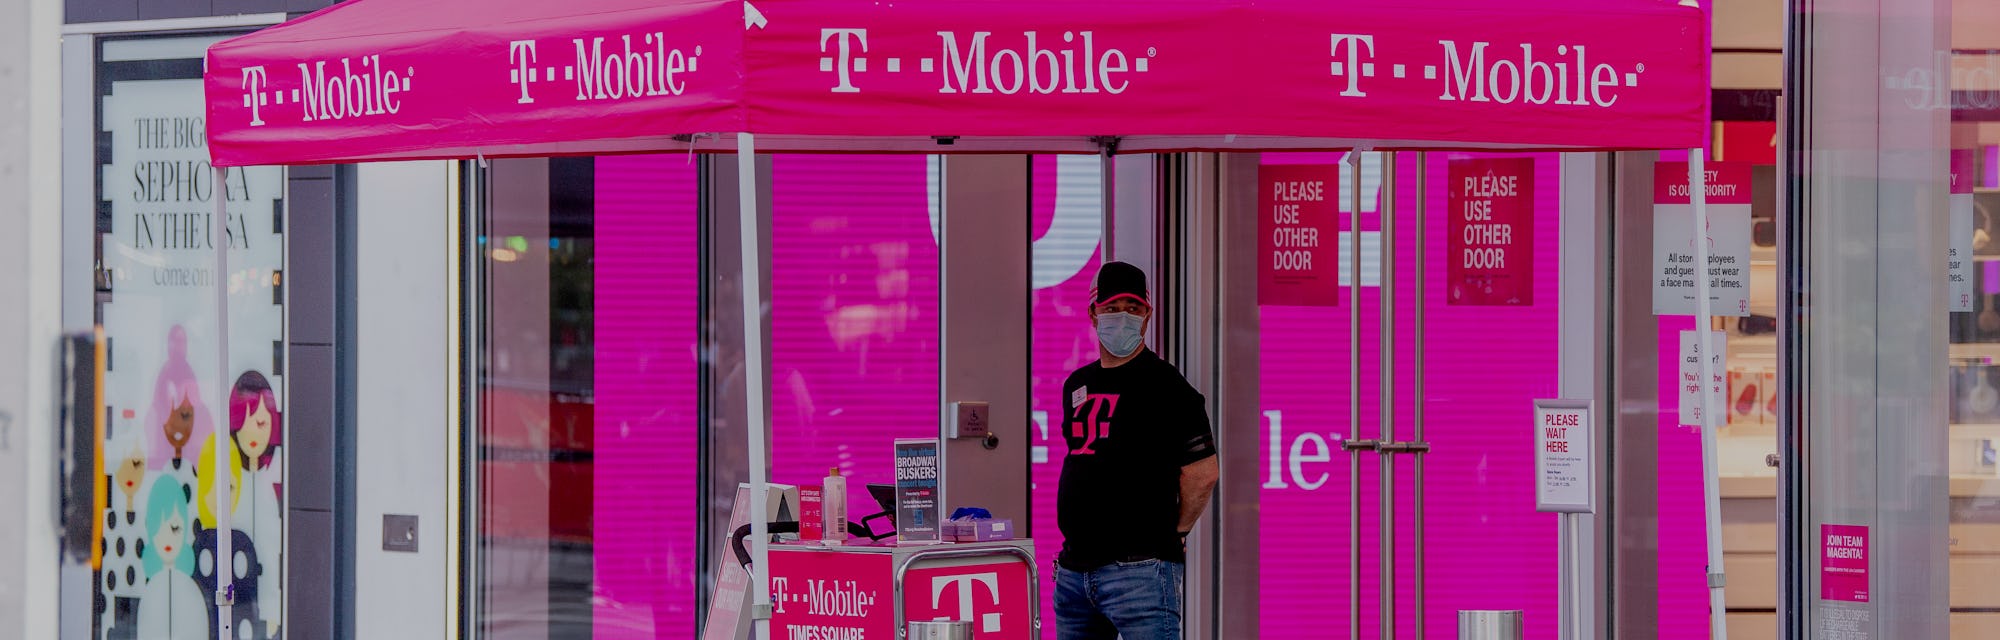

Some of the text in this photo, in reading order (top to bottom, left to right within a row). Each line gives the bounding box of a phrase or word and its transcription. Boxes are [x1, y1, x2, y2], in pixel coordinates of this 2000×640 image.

[135, 116, 208, 149] THE BIG
[1273, 180, 1324, 202] PLEASE
[1464, 175, 1518, 197] PLEASE
[1668, 184, 1677, 197] IS
[1703, 184, 1737, 197] RIORITY
[1273, 204, 1300, 225] USE
[1464, 200, 1492, 221] USE
[135, 212, 153, 249] IN
[158, 212, 201, 249] THE
[1273, 227, 1319, 248] OTHER
[1463, 224, 1512, 245] OTHER
[1273, 250, 1312, 271] DOOR
[1463, 248, 1505, 269] DOOR
[1668, 253, 1678, 263] All
[1707, 253, 1735, 268] ployees
[1664, 265, 1678, 276] and
[1722, 267, 1740, 276] wear
[1666, 277, 1683, 288] face
[1684, 279, 1695, 288] ma
[1710, 278, 1719, 288] all
[1720, 278, 1743, 288] times.
[1686, 383, 1700, 394] righ
[1545, 414, 1579, 426] PLEASE
[1545, 427, 1567, 439] WAIT
[1546, 441, 1568, 453] HERE
[897, 455, 936, 468] BROADWAY
[897, 466, 937, 480] BUSKERS
[1826, 534, 1864, 547] JOIN TEAM
[1826, 546, 1864, 560] MAGENTA!
[786, 624, 865, 640] TIMES SQUARE
